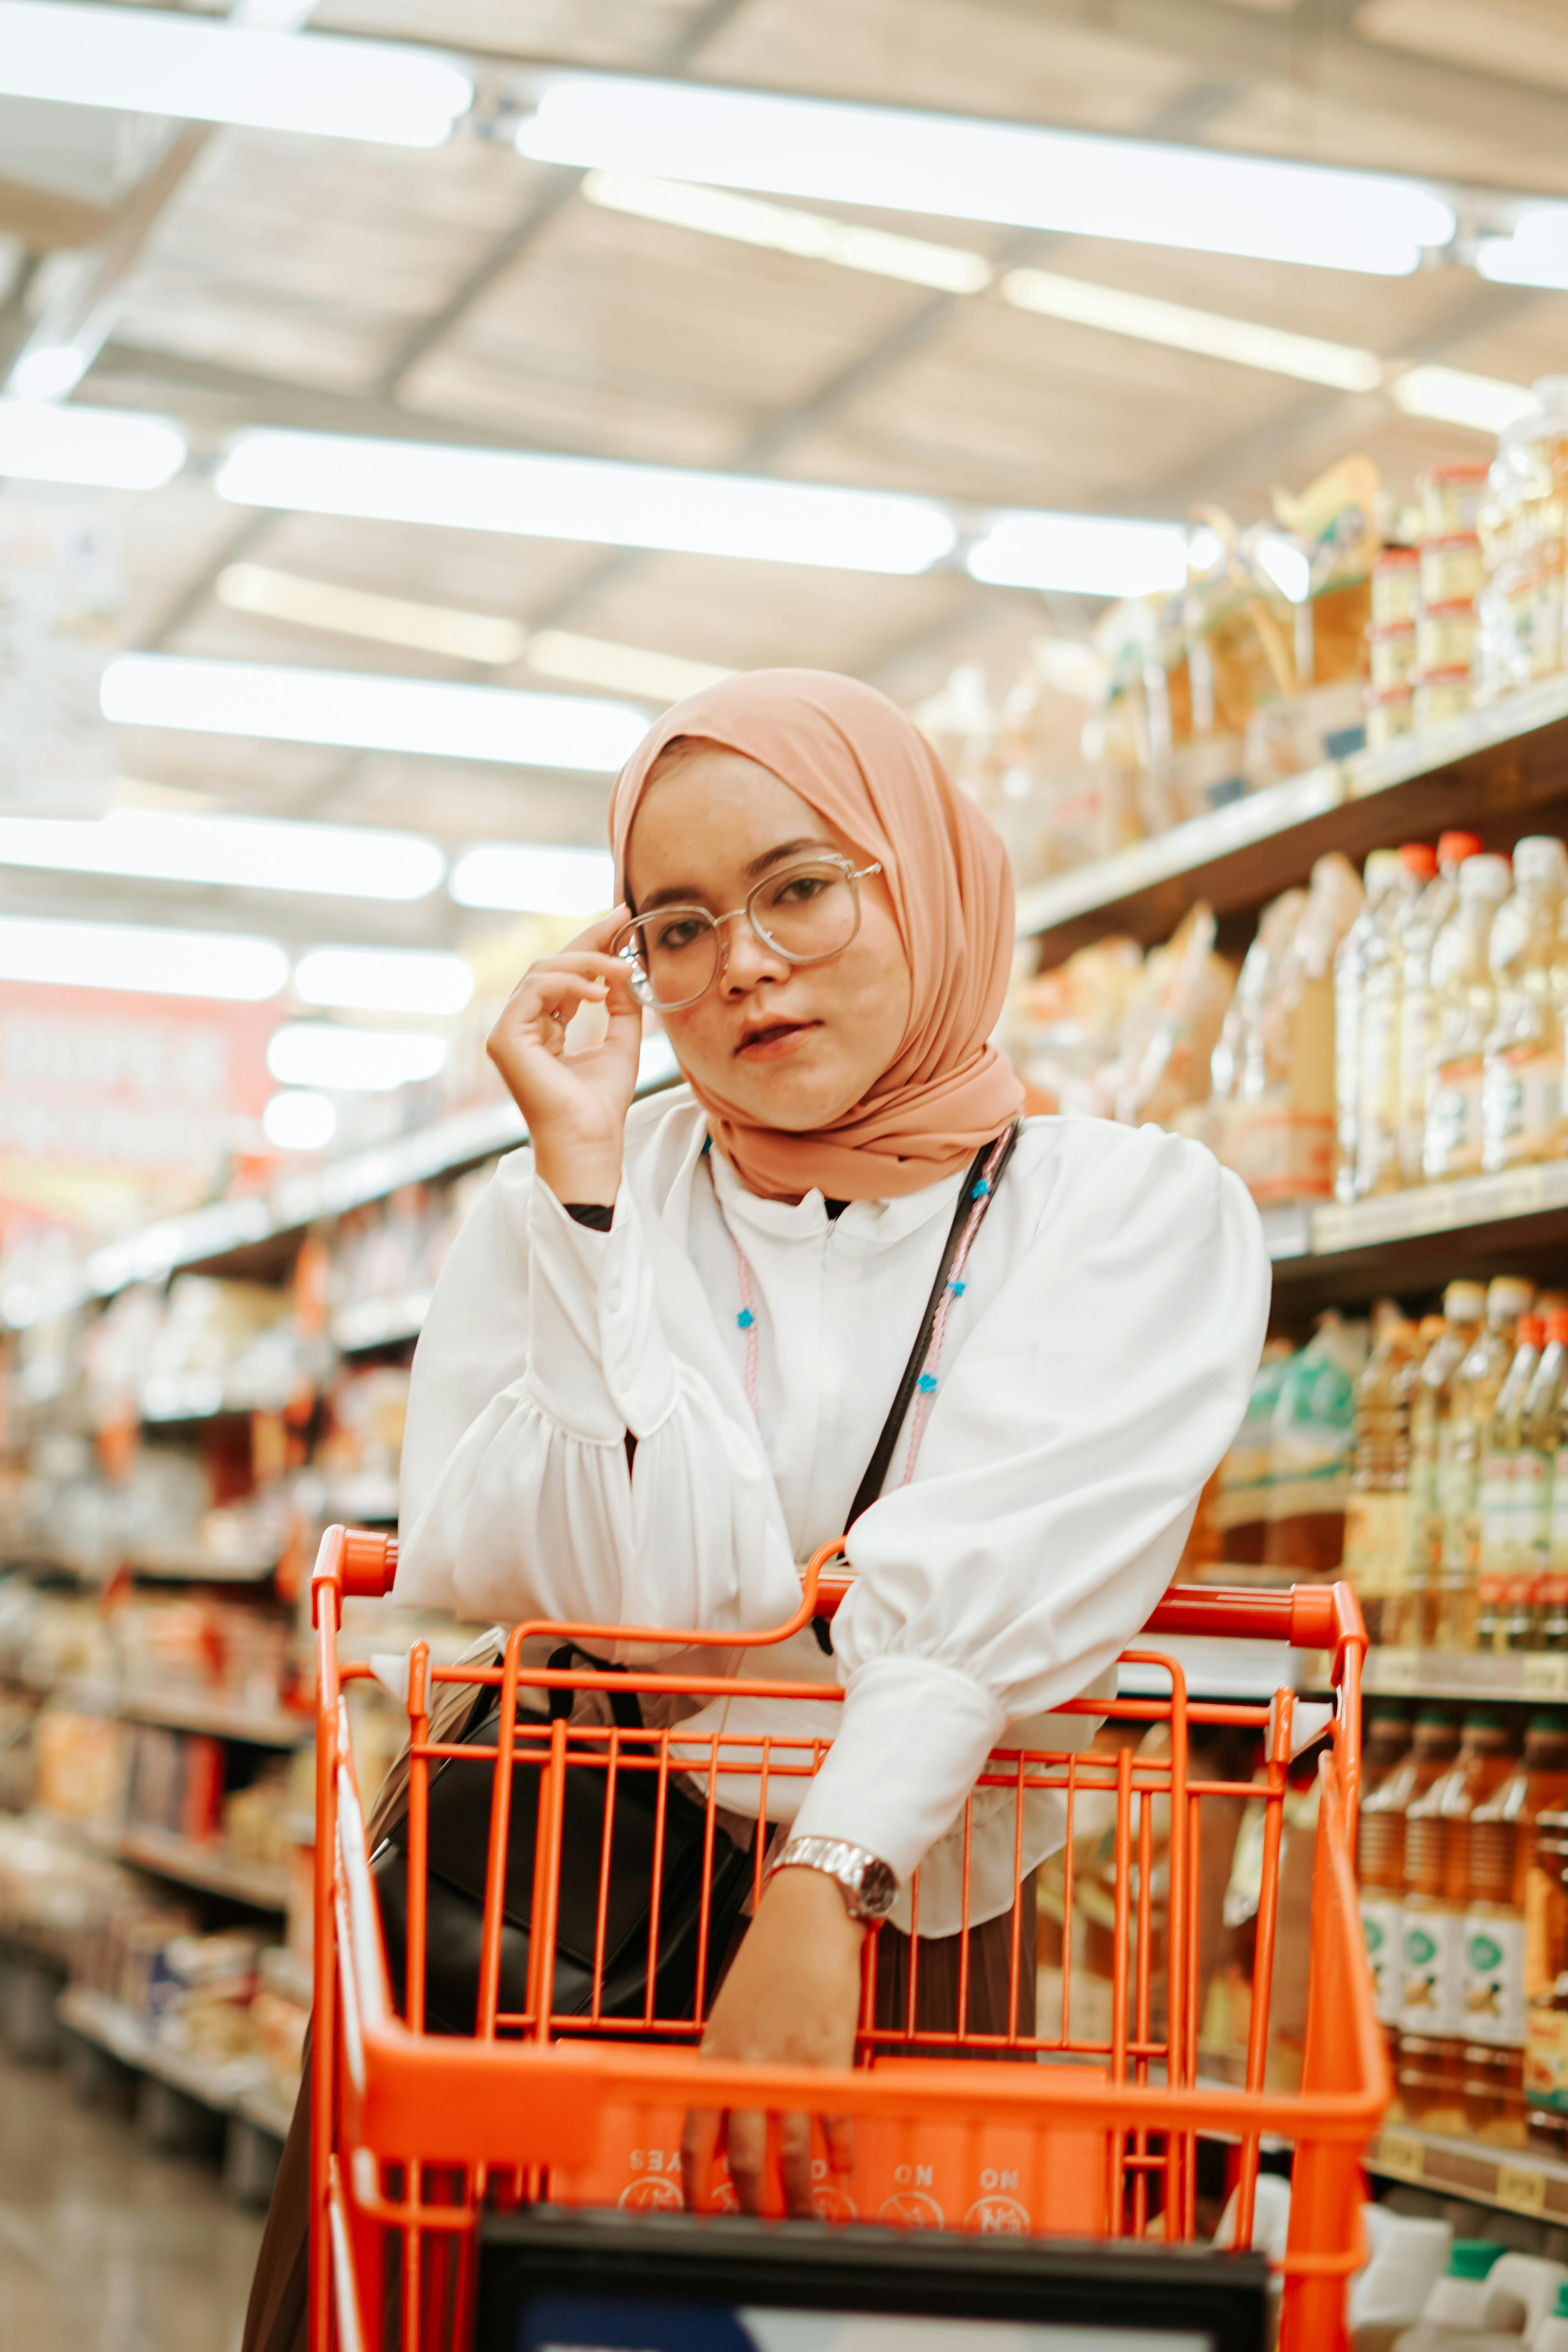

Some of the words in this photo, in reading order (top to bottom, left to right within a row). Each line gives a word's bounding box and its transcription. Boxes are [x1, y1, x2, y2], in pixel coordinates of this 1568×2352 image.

[629, 2149, 682, 2172] YES
[894, 2163, 933, 2187] NO
[980, 2167, 1018, 2190] NO
